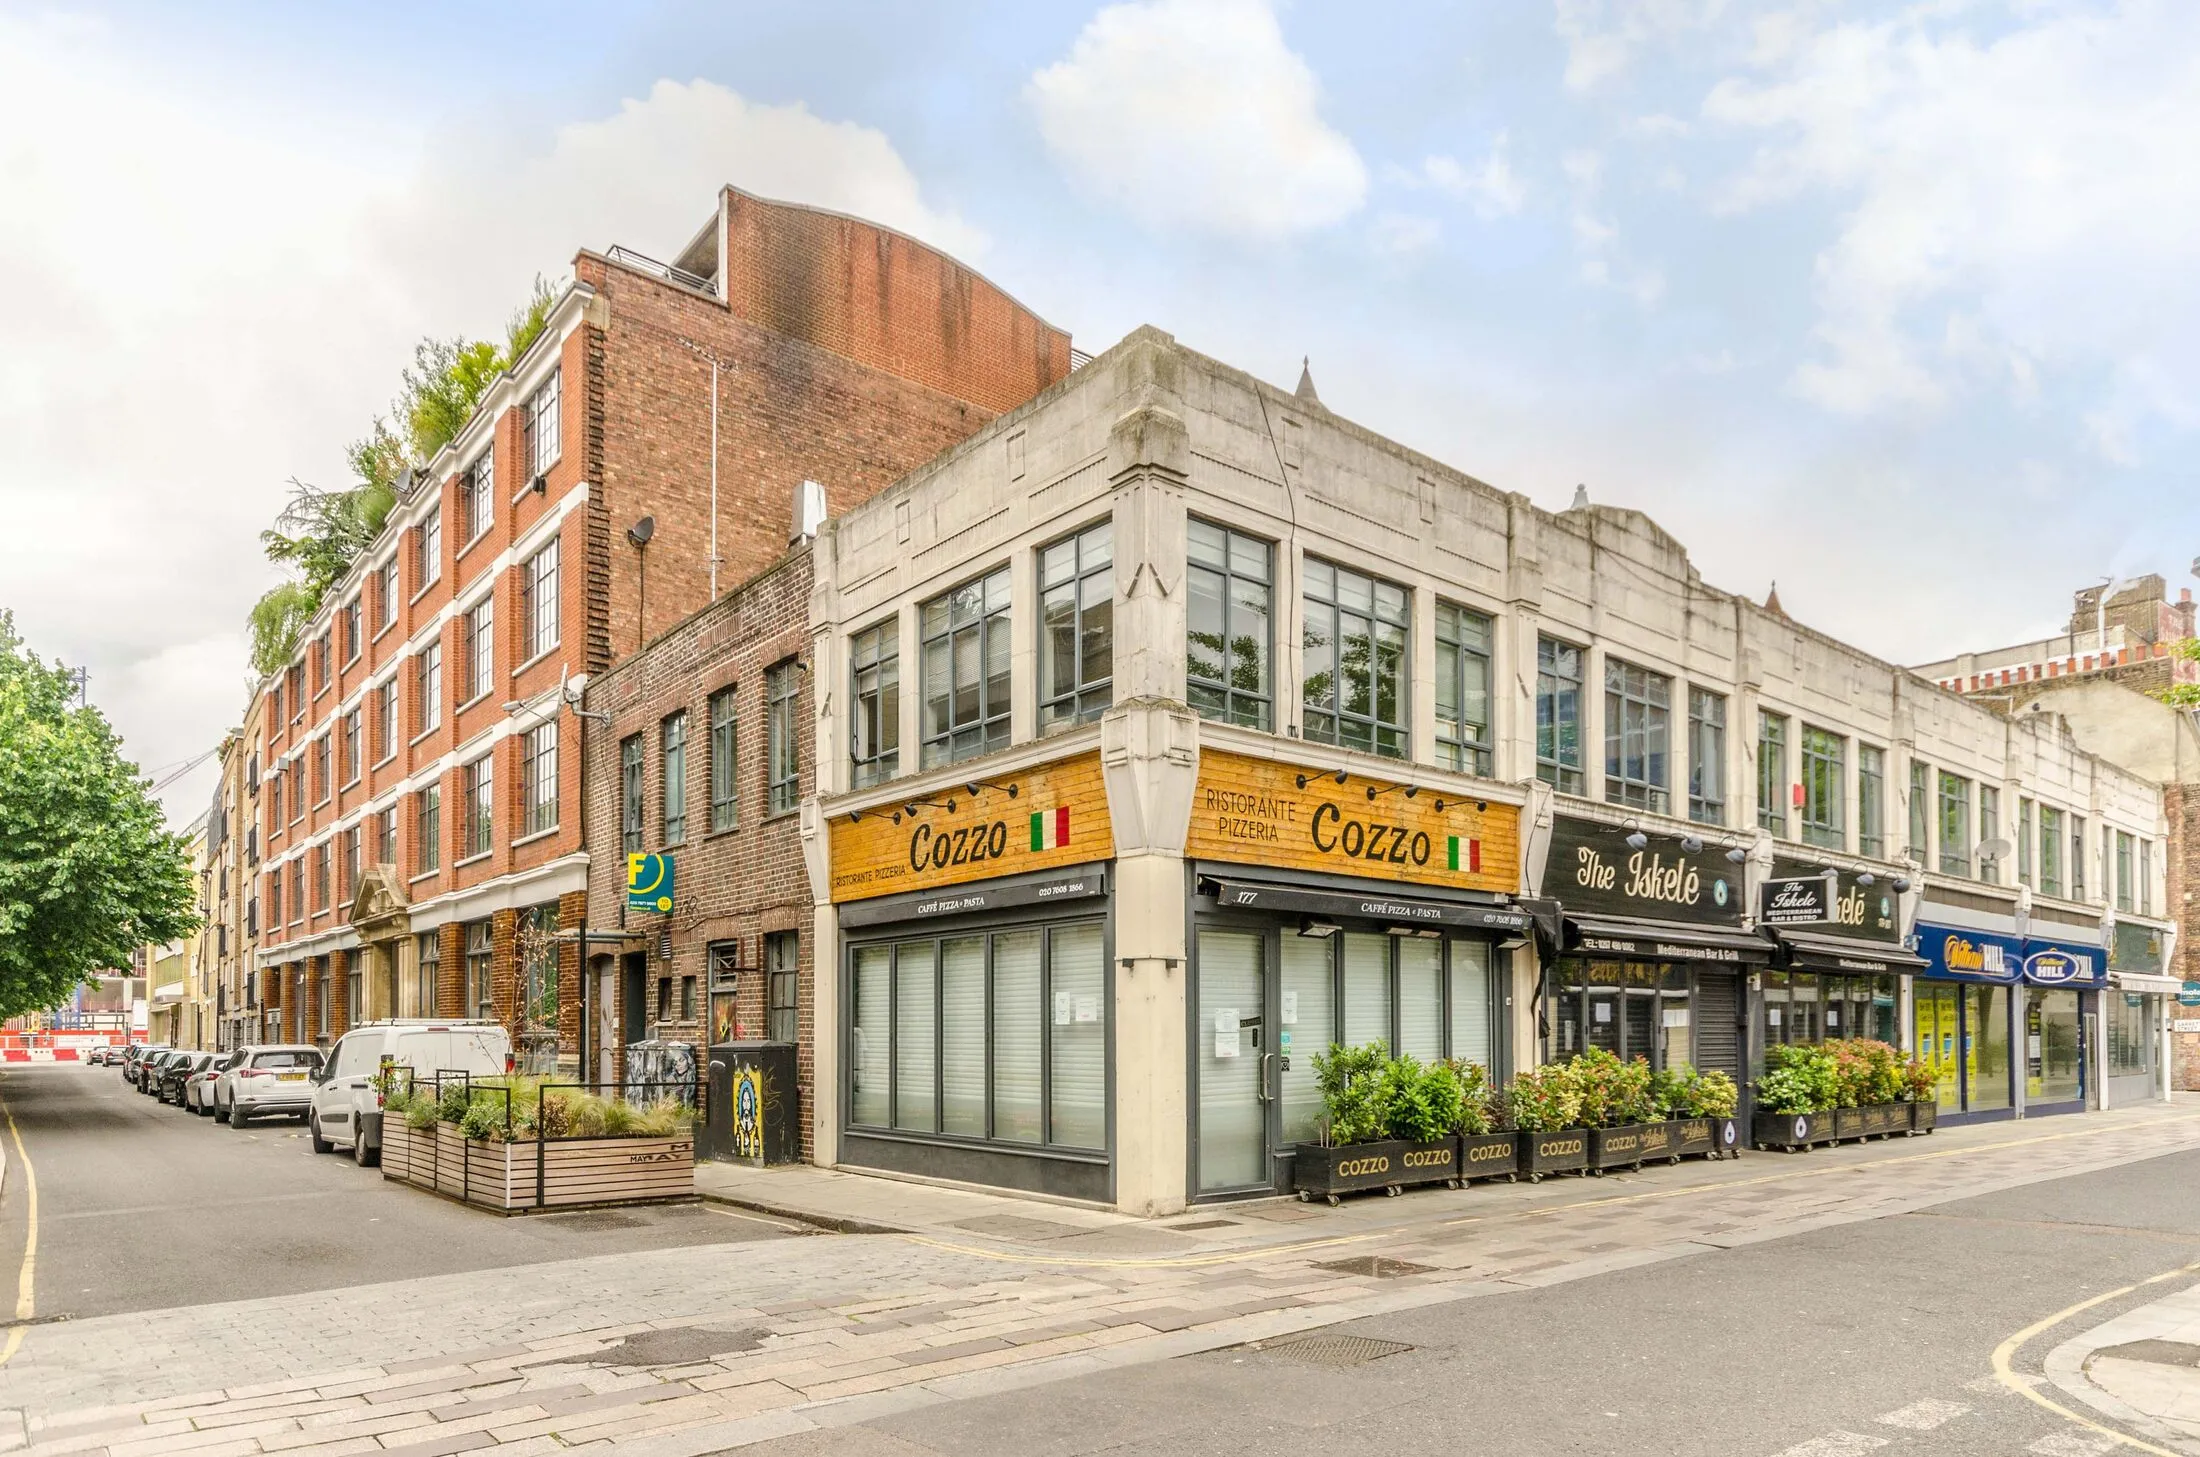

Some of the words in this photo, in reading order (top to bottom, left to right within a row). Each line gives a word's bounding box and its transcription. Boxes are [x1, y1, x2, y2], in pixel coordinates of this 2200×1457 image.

[1206, 788, 1297, 822] RISTORANTE
[1218, 817, 1279, 843] PIZZERIA
[1311, 802, 1431, 867] Cozzo
[910, 820, 1007, 873] Cozzo
[835, 871, 873, 888] RISTORANTE
[875, 864, 906, 881] PIZZERIA
[1577, 846, 1616, 890] The
[1624, 850, 1700, 905] Iskelé
[1039, 887, 1052, 897] 020
[1783, 882, 1804, 892] The
[938, 900, 959, 911] PIZZA
[963, 896, 985, 908] PASTA
[1236, 890, 1258, 905] 177
[1361, 902, 1388, 914] CAFFÉ
[1387, 905, 1410, 916] PIZZA
[1416, 907, 1441, 919] PASTA
[1766, 908, 1823, 916] MEDITERRANEAN
[1657, 944, 1705, 959] Mediterranean
[1706, 948, 1717, 959] Bar
[1983, 944, 2005, 972] HILL
[2036, 965, 2065, 978] HILL
[1469, 1143, 1511, 1162] COZZO
[1539, 1139, 1582, 1157] COZZO
[1605, 1135, 1637, 1152] COZZO
[1338, 1156, 1389, 1177] COZZO
[1403, 1149, 1451, 1167] COZZO
